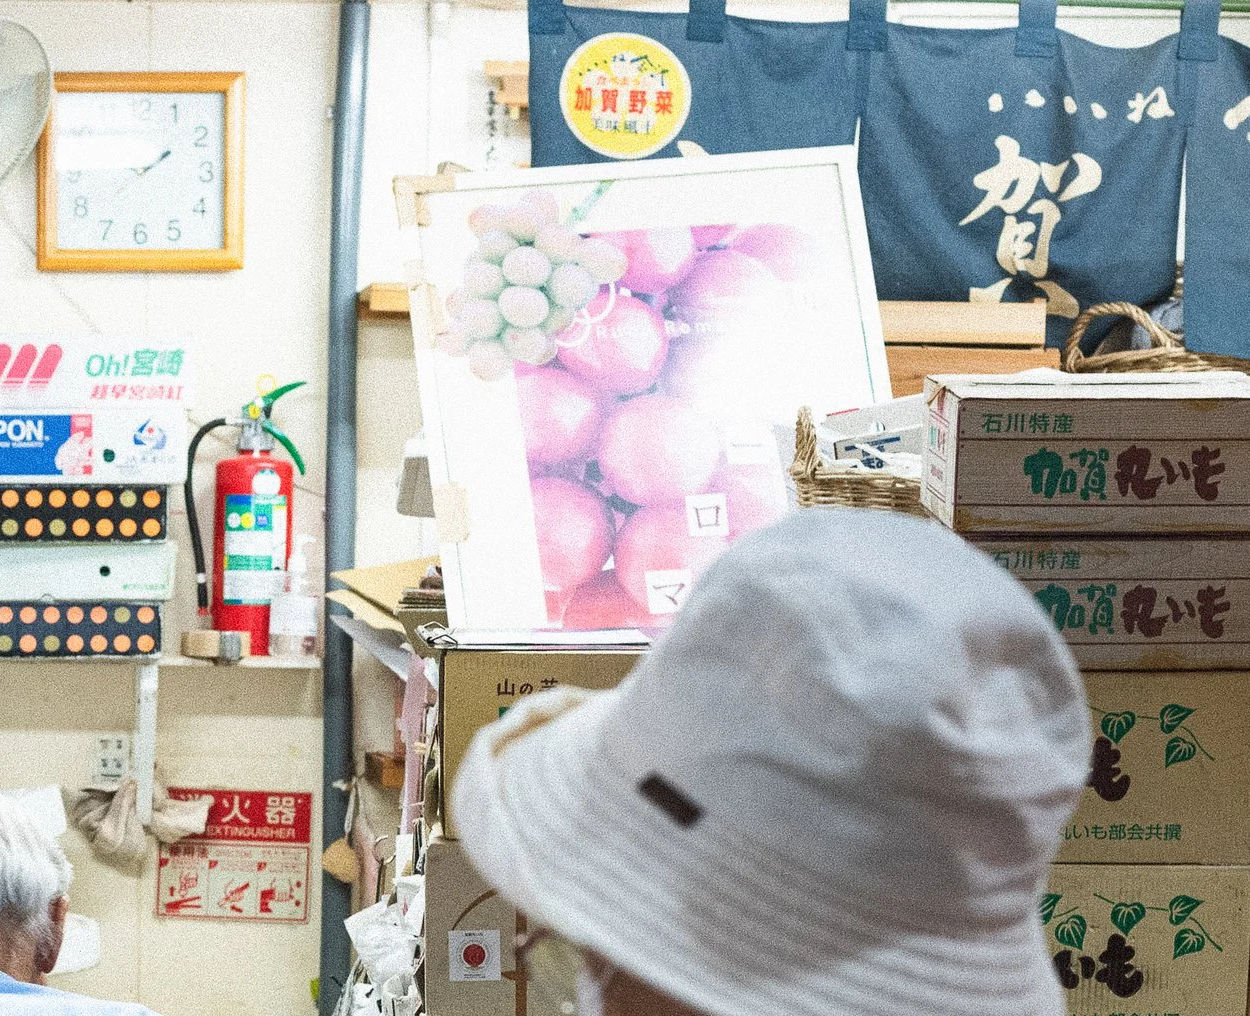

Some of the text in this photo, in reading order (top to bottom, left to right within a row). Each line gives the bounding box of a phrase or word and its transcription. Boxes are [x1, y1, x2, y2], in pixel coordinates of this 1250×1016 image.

[574, 86, 674, 117] 加賀野菜
[193, 126, 210, 148] 2
[199, 161, 214, 183] 3
[74, 196, 88, 218] 8
[192, 198, 207, 218] 4
[100, 219, 114, 241] 7
[133, 222, 149, 245] 6
[166, 219, 182, 242] 5
[981, 412, 1074, 435] 石川特産
[652, 583, 685, 605] マ
